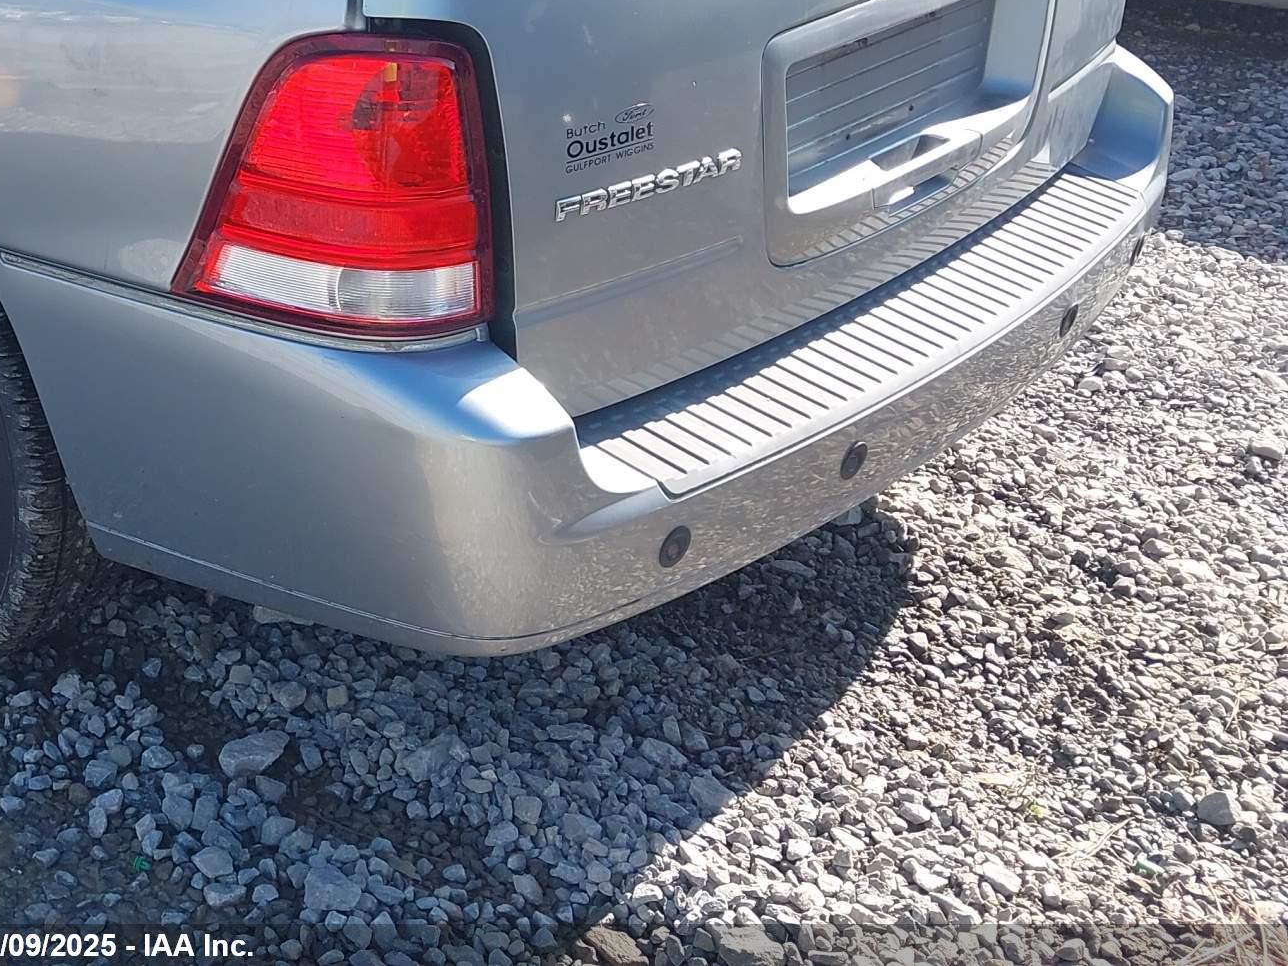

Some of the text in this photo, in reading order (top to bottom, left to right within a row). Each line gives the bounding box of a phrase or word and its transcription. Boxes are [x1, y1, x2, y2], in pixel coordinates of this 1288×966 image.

[566, 121, 606, 139] Butch
[566, 121, 654, 159] Oustalet
[565, 143, 655, 174] GULFPORT WIGGINS
[555, 147, 743, 222] FREESTAR
